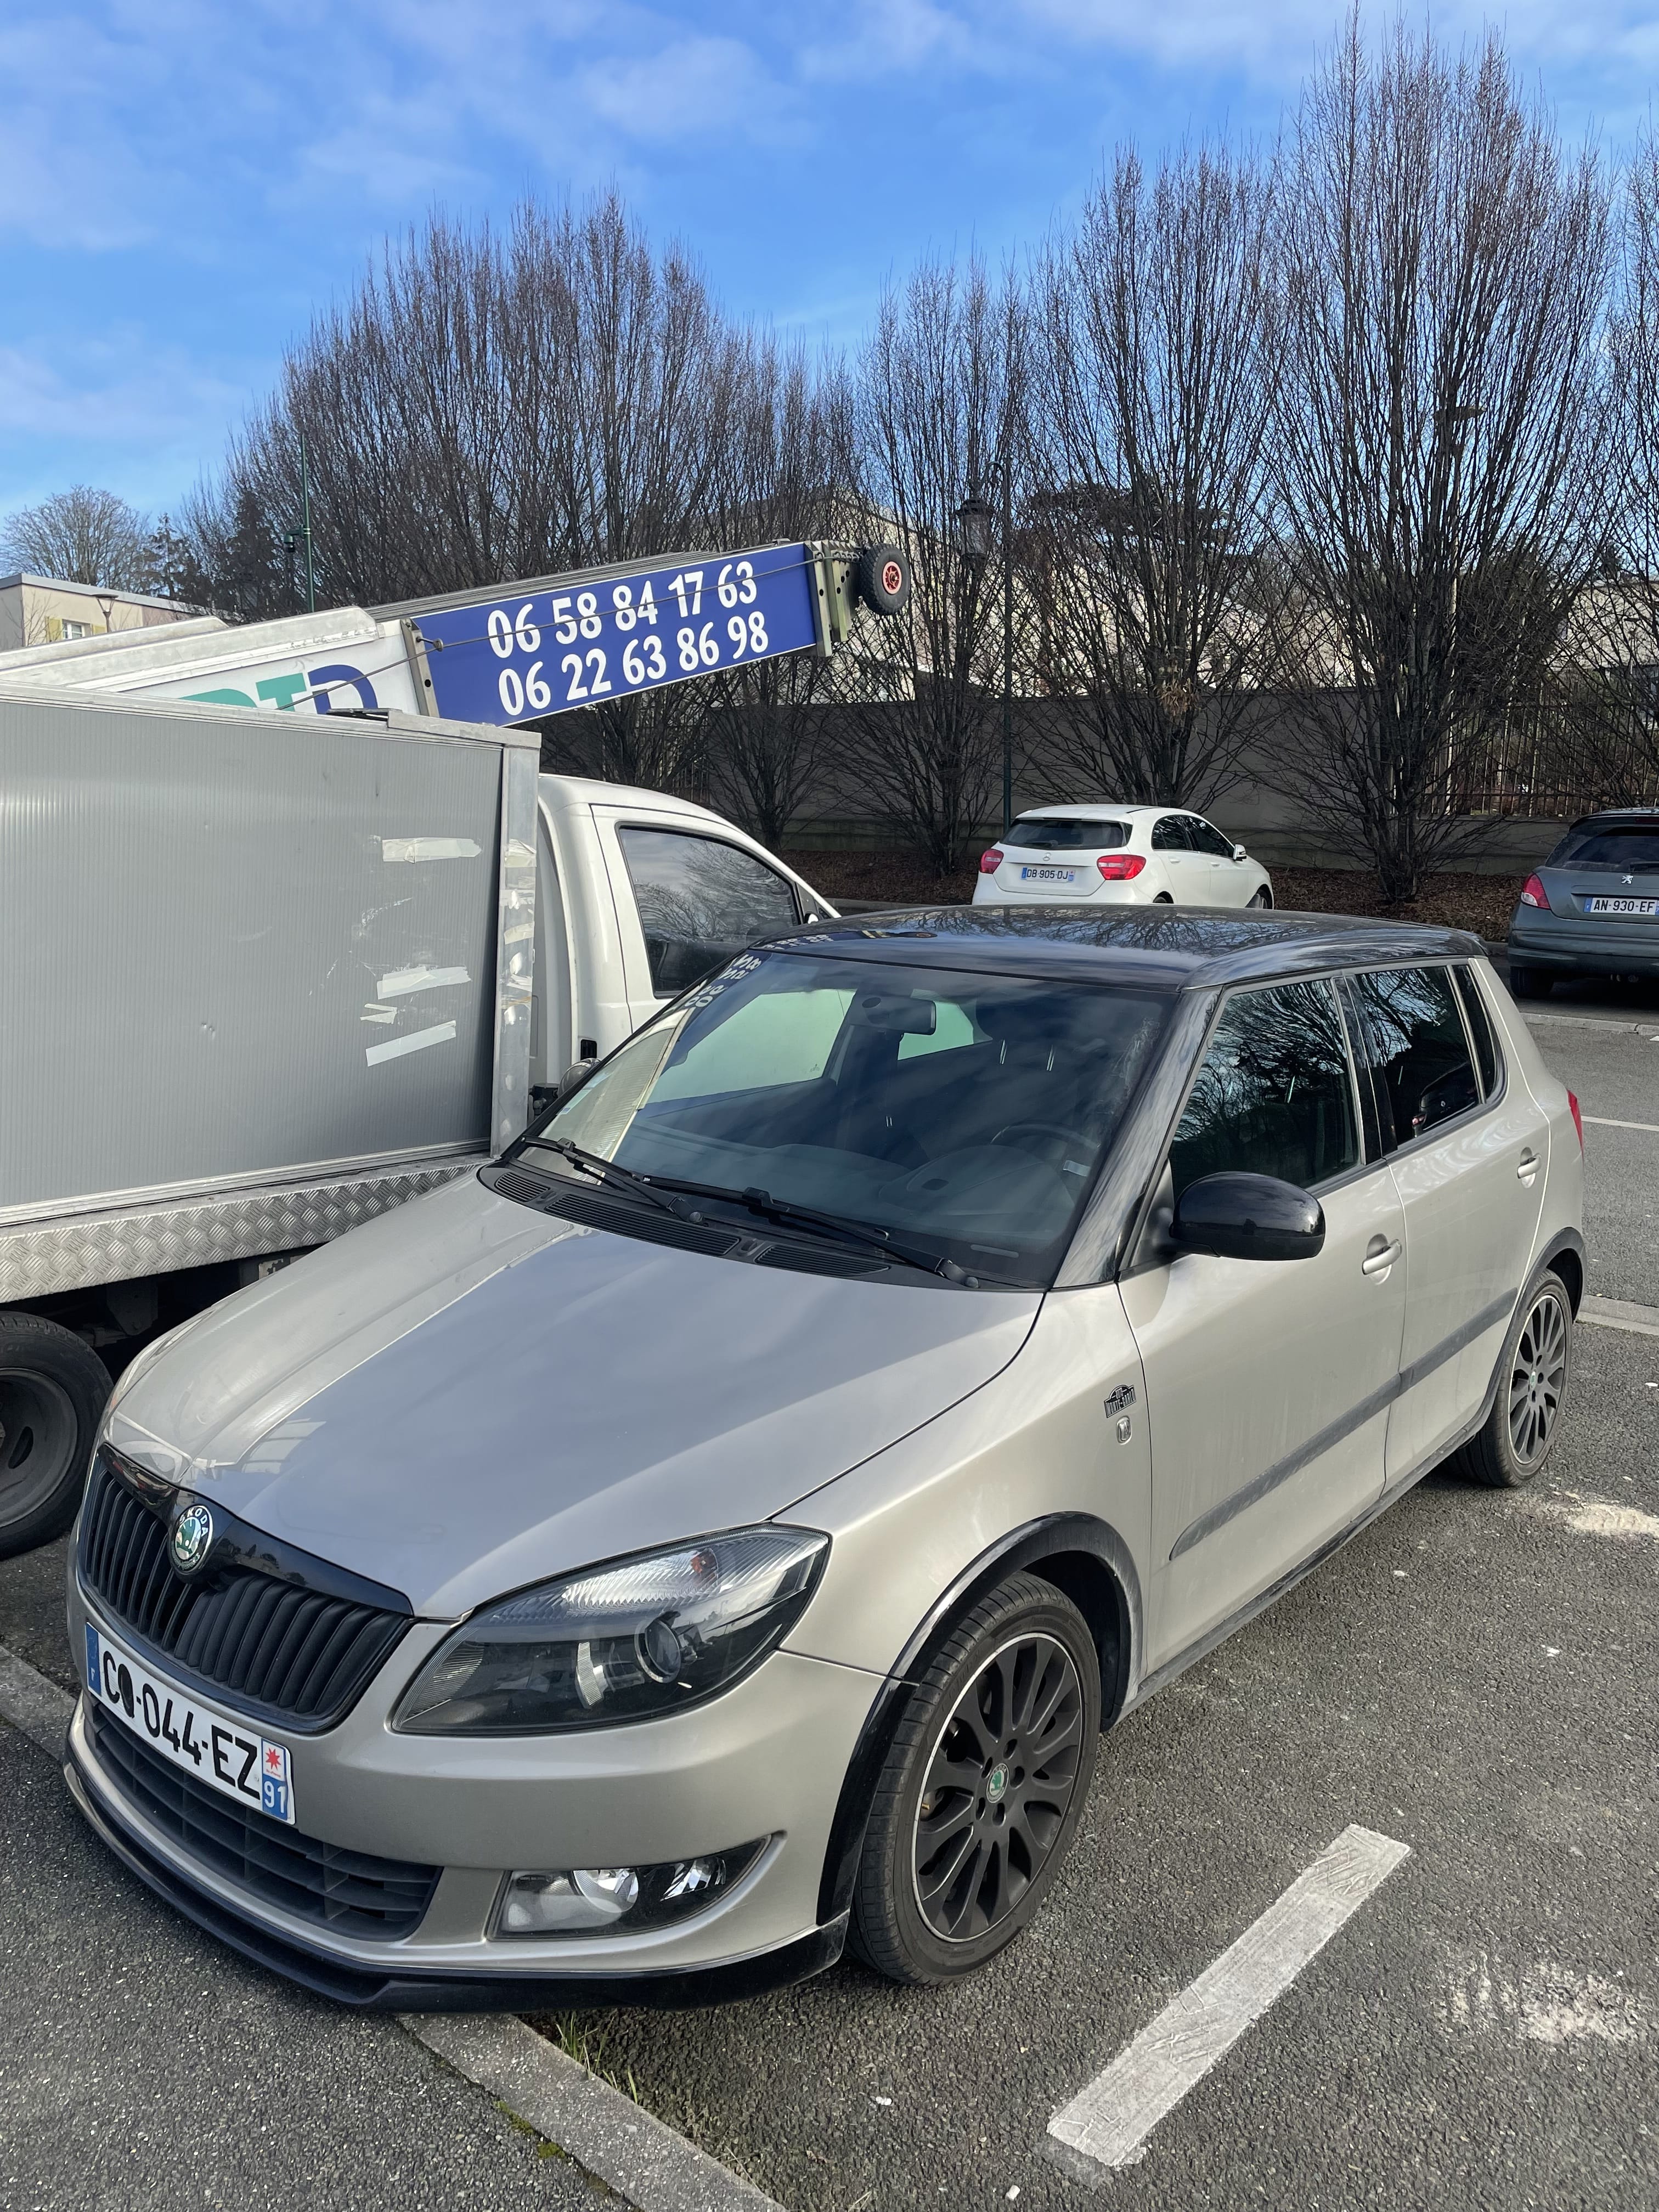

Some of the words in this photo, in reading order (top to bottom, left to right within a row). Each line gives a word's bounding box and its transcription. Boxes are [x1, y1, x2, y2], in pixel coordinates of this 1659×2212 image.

[487, 603, 541, 658] 06
[552, 592, 602, 645] 58
[612, 580, 658, 631] 84
[668, 571, 704, 618] 17
[718, 561, 757, 608] 63
[498, 661, 551, 716] 06
[561, 648, 612, 701] 22
[623, 635, 667, 685] 63
[676, 622, 719, 671] 86
[727, 611, 769, 659] 98
[1026, 869, 1068, 879] DB-905-DJ
[1593, 899, 1655, 913] AN-930-EF
[264, 1781, 286, 1813] 91
